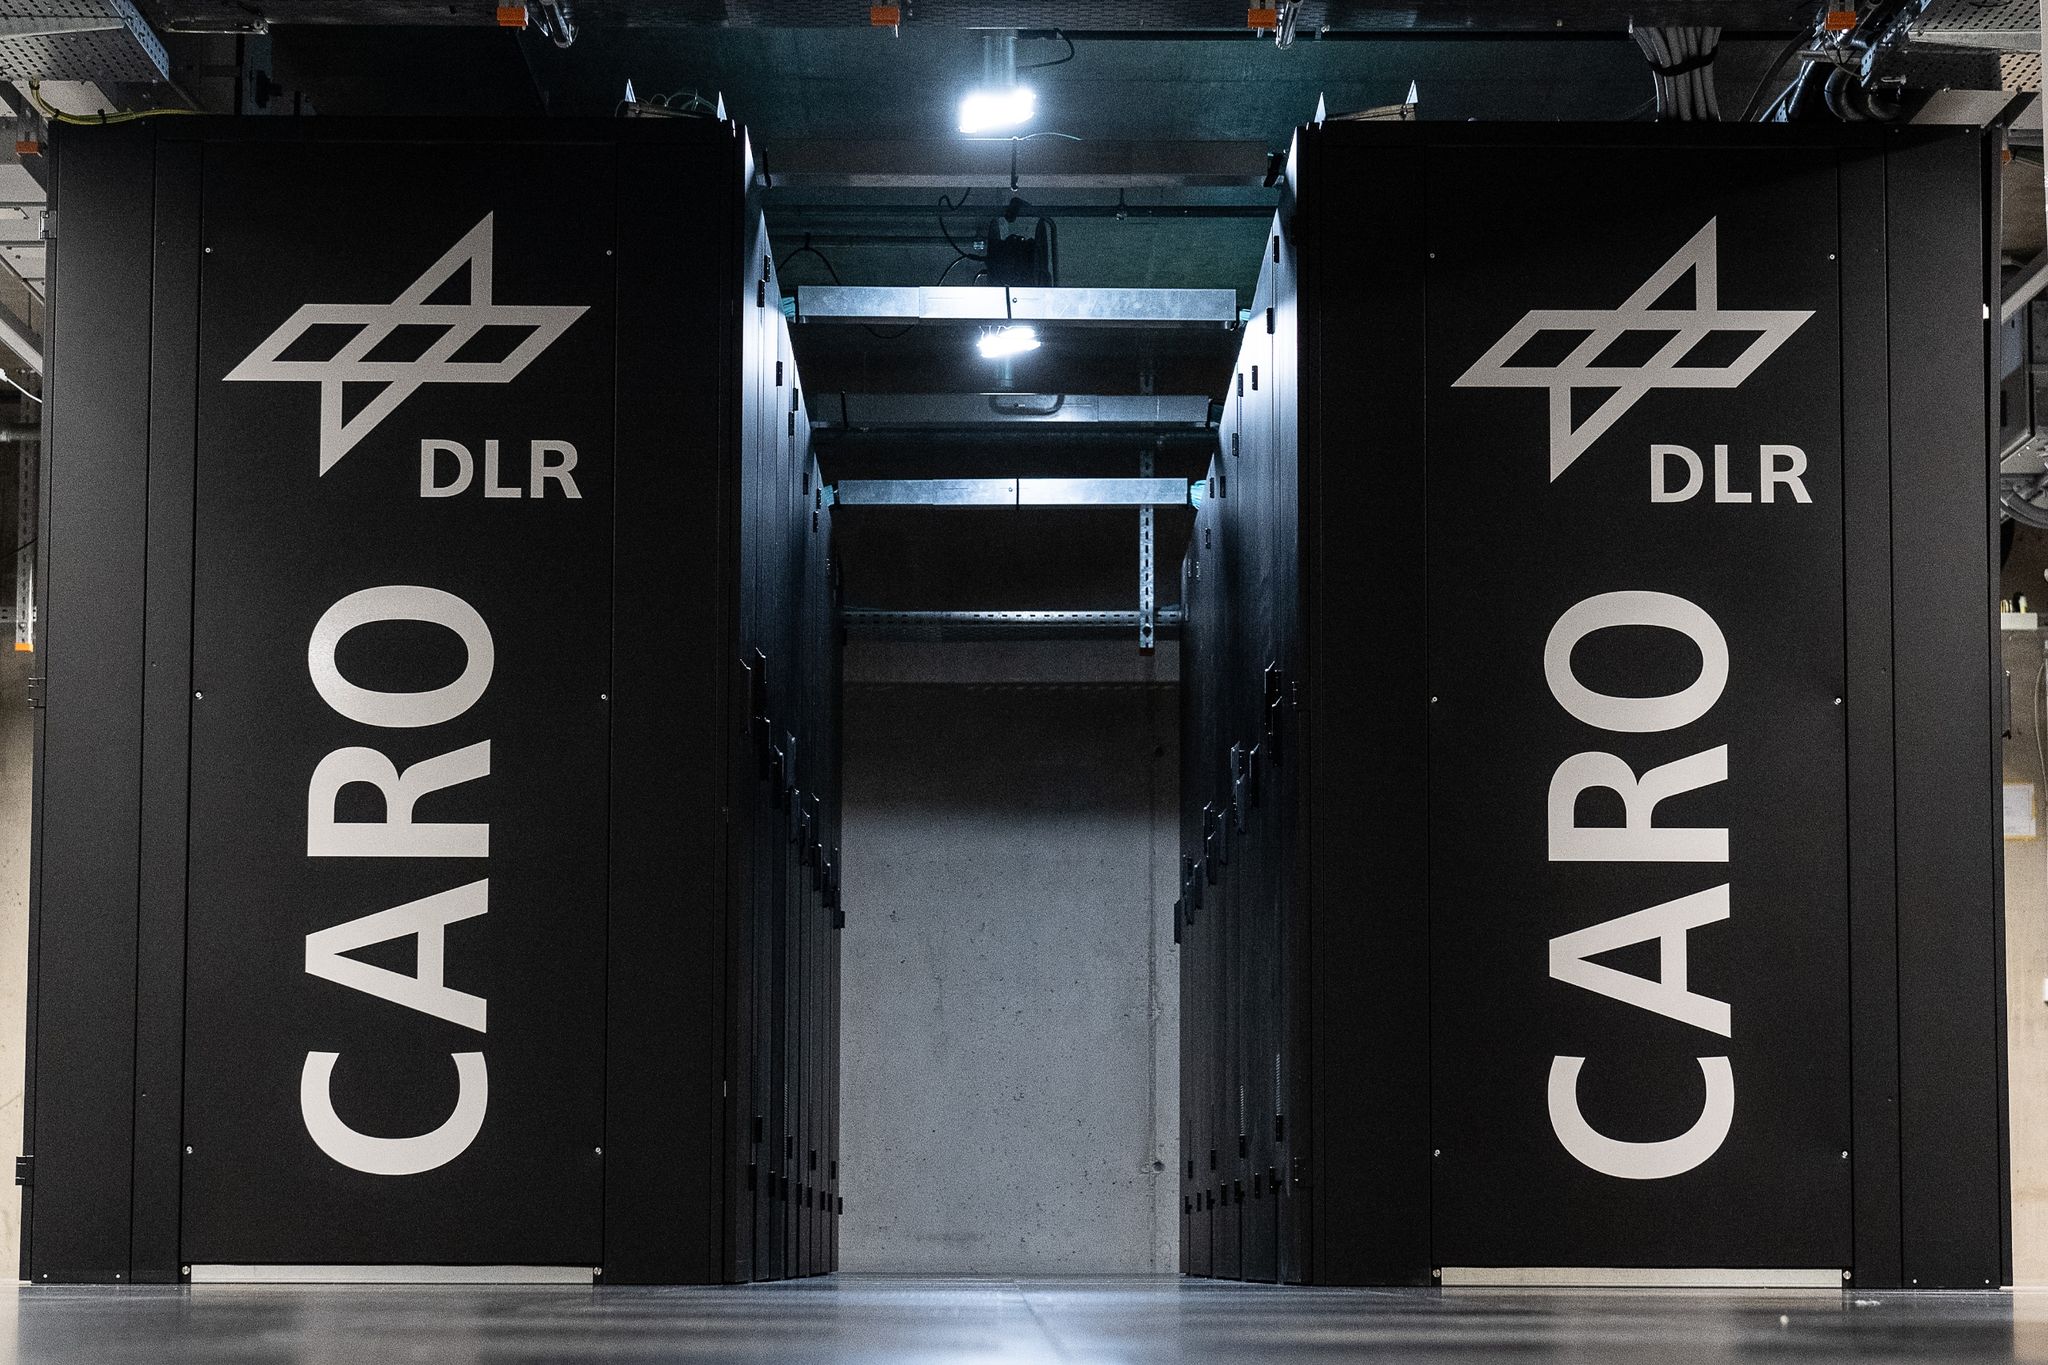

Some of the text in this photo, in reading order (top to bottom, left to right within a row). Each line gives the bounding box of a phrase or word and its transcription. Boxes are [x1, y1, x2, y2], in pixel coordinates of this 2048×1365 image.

[420, 439, 582, 499] DLR
[1651, 444, 1812, 504] DLR
[301, 585, 495, 1176] CARO
[1544, 590, 1735, 1180] CARO
